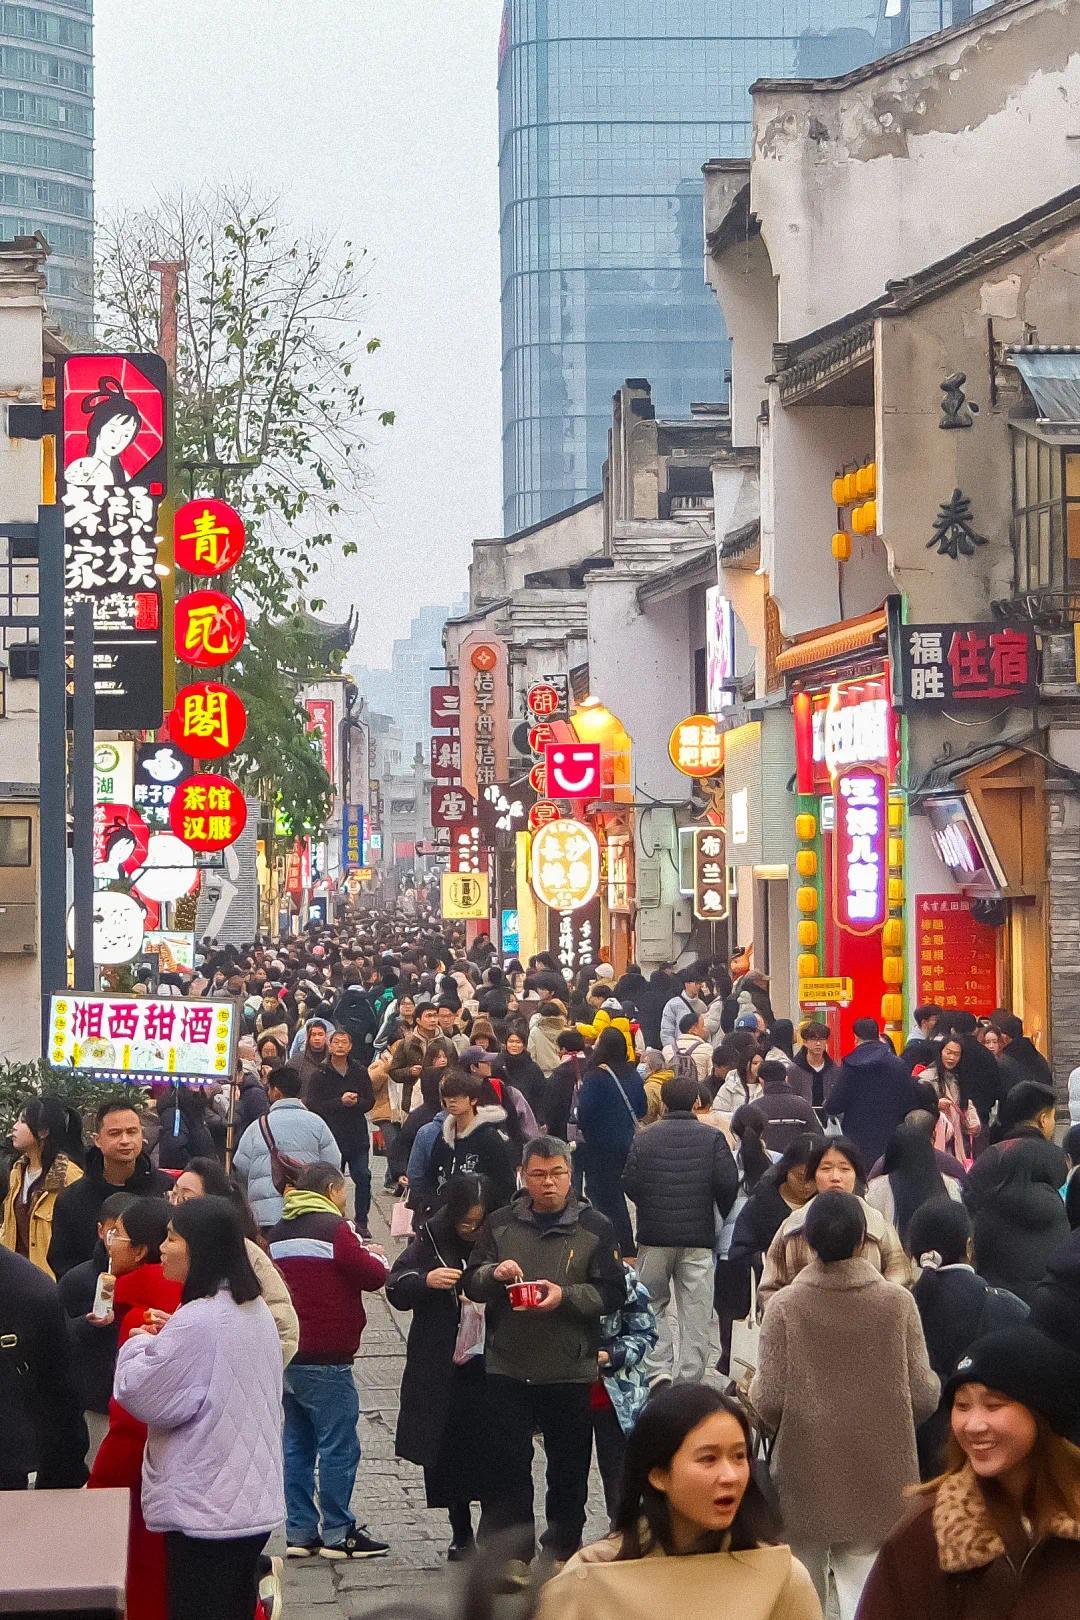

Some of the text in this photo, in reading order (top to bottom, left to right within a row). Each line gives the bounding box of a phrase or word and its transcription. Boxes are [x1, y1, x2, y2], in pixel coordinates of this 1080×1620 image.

[64, 536, 156, 589] 家族
[910, 632, 944, 699] 福胜
[947, 628, 1029, 687] 住宿
[183, 786, 232, 811] 茶馆
[183, 815, 232, 840] 汉服
[71, 1000, 214, 1044] 湘西甜酒
